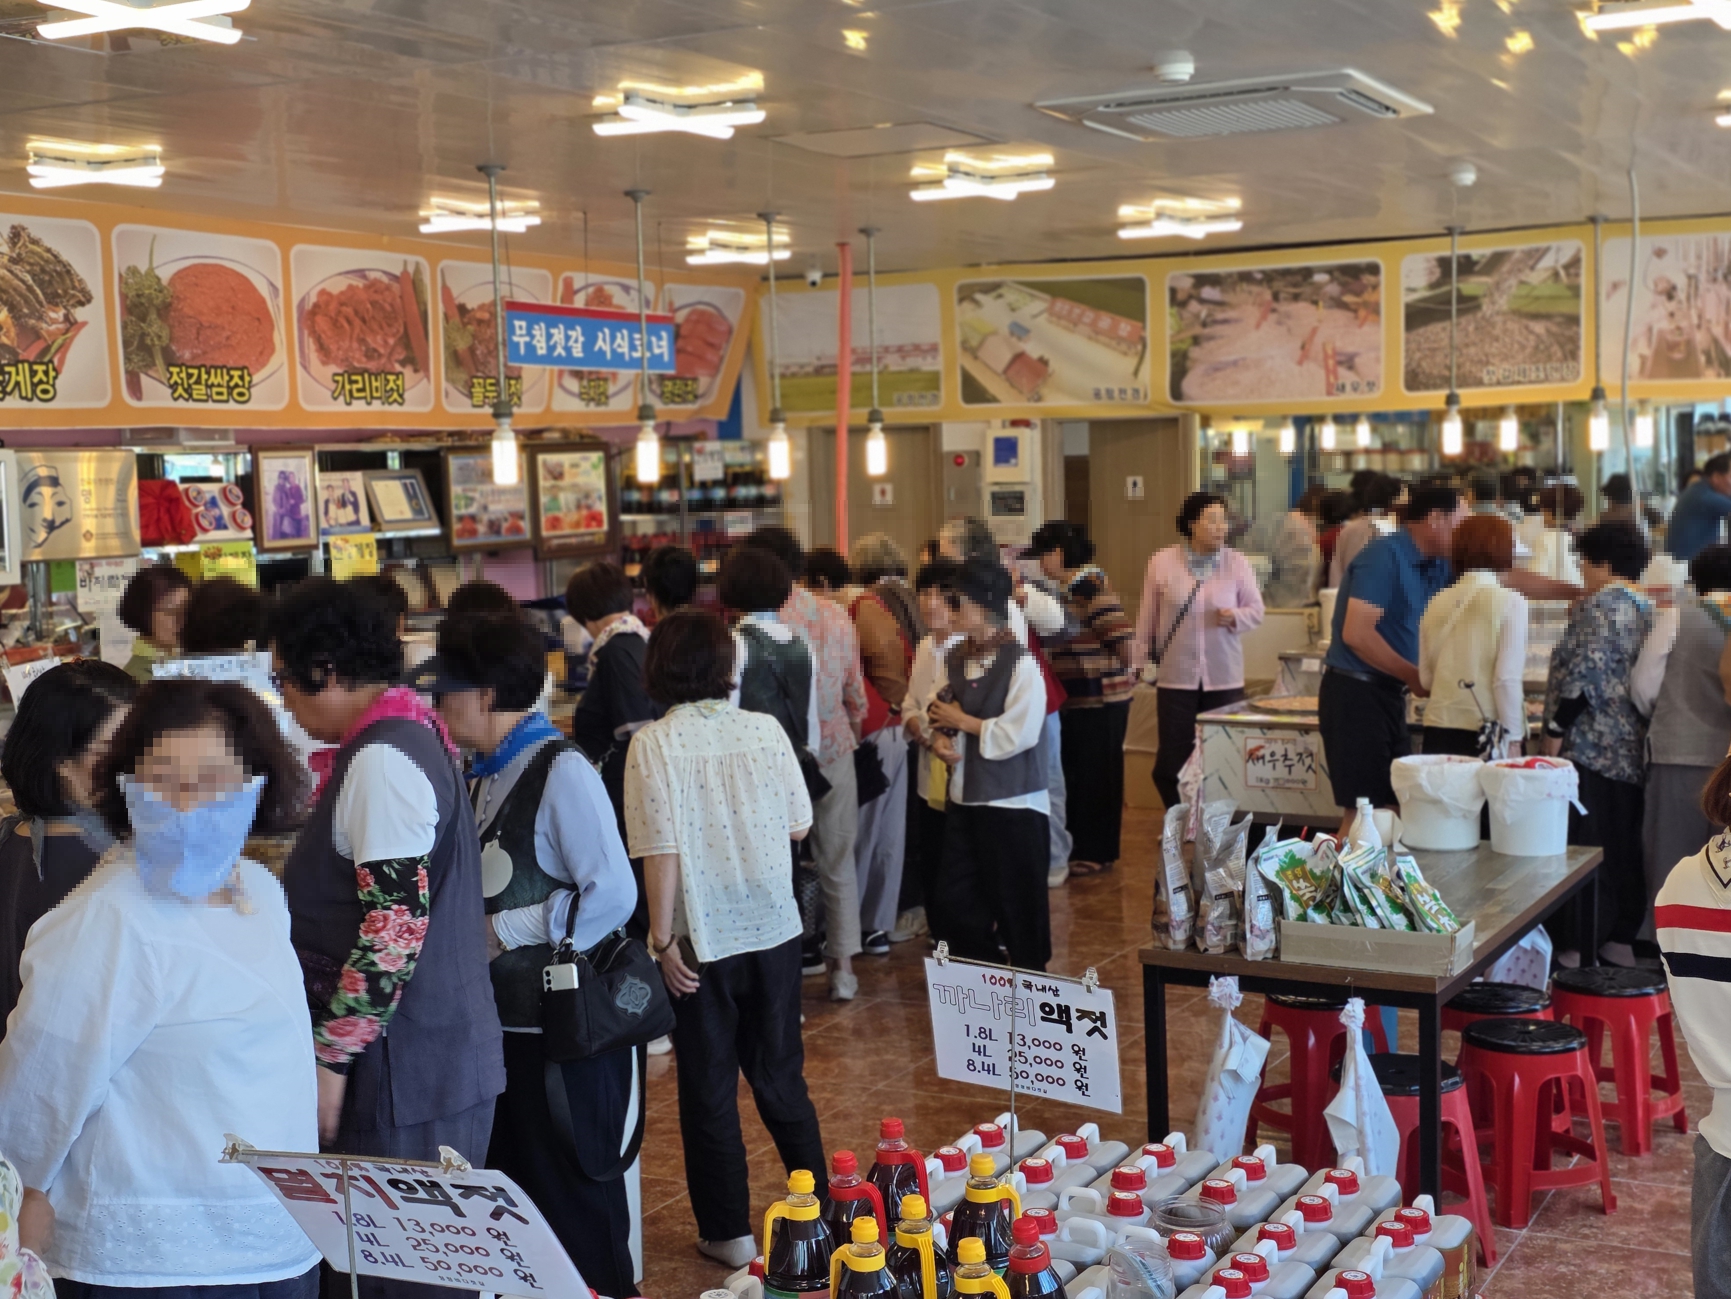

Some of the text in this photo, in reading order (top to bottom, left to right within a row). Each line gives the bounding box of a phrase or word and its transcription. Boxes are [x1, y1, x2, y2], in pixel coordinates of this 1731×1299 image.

[511, 320, 670, 362] 무침젓갈 시식코너
[0, 361, 57, 401] 게장
[168, 366, 252, 402] 젓갈쌈장
[332, 371, 405, 405] 가리비젓
[1246, 747, 1317, 776] 새우추젓
[1022, 979, 1060, 997] 국내산
[933, 983, 1109, 1040] 까나리액젓
[964, 1024, 1088, 1061] 1.8L 13,000 원
[972, 1042, 1089, 1079] 4L 25,000 원
[966, 1059, 1091, 1097] 8.4L 50,000 원
[257, 1166, 530, 1226] 멸치액젓
[332, 1210, 517, 1248] 1.8L 13,000 원
[356, 1231, 531, 1269] 4L 25,000 원
[361, 1250, 544, 1291] 8.4L 50,000 원
